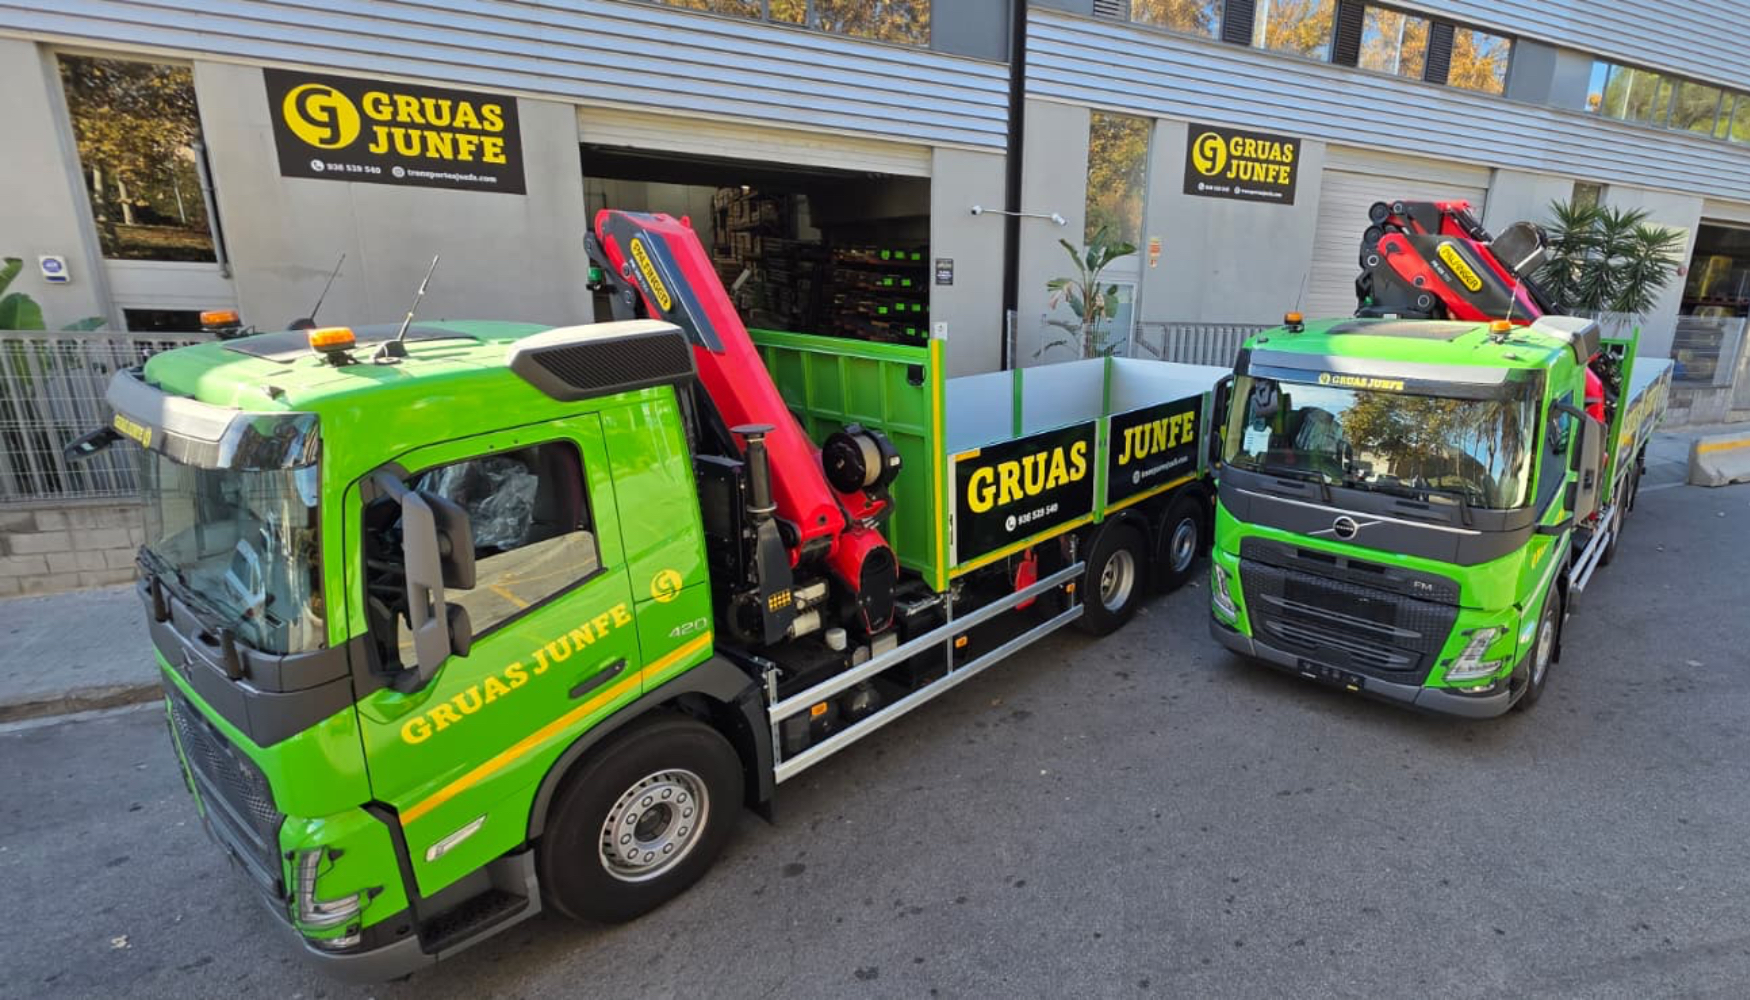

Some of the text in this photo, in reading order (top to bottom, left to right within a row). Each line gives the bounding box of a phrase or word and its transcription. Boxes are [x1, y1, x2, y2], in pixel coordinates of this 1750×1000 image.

[362, 91, 504, 132] GRUAS
[369, 125, 506, 164] JUNFE
[1229, 137, 1294, 163] GRUAS
[1226, 159, 1291, 185] JUNFE
[1332, 375, 1404, 390] GRUAS JUNFE
[1118, 410, 1195, 466] JUNFE
[967, 440, 1087, 513] GRUAS
[1413, 581, 1433, 591] FM
[668, 616, 708, 637] 420
[401, 602, 632, 745] GRUAS JUNFE
